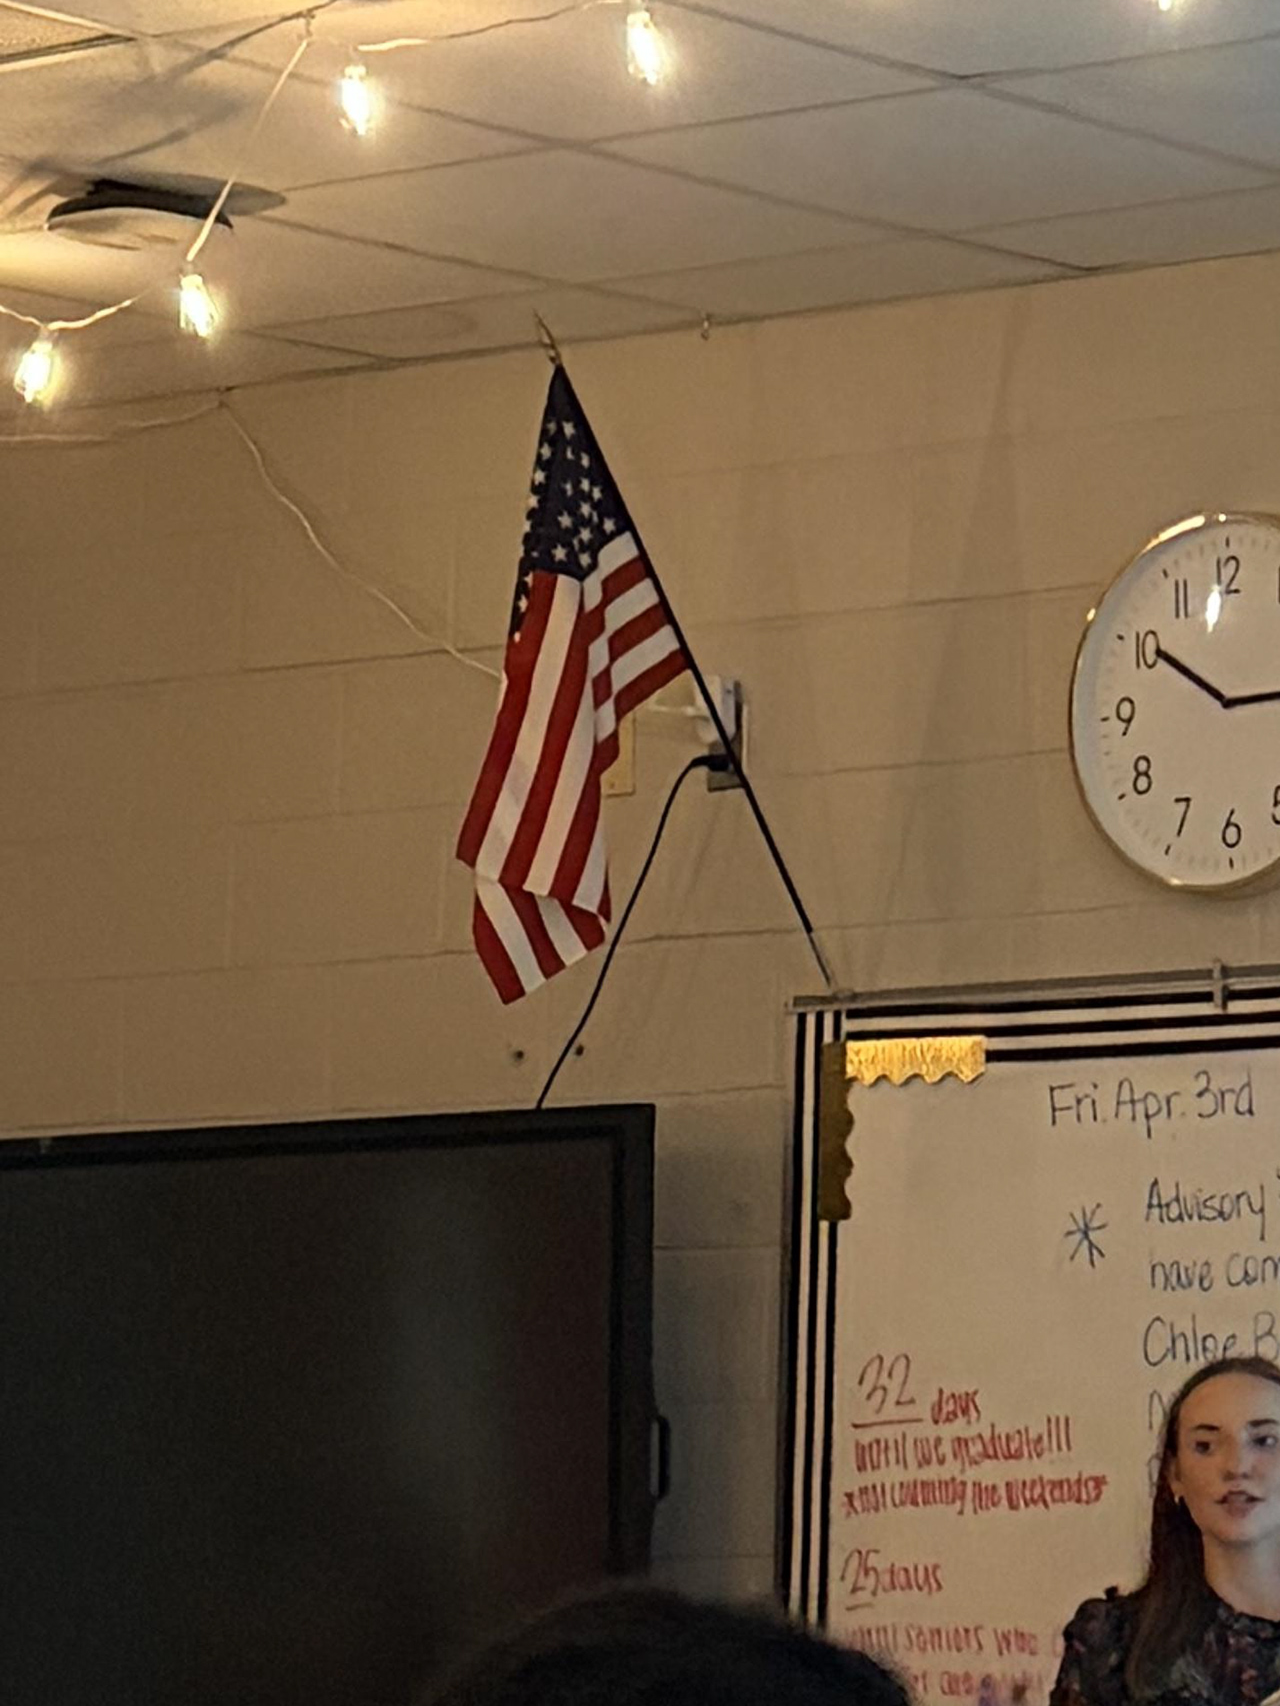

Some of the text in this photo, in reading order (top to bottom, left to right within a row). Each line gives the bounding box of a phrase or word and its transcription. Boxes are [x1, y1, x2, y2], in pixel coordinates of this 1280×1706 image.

[1215, 555, 1241, 595] 12
[1173, 578, 1190, 619] 11
[1135, 629, 1160, 670] 10
[1115, 696, 1136, 737] 9
[1132, 755, 1153, 795] 8
[1173, 797, 1192, 837] 7
[1221, 808, 1242, 849] 6
[1047, 1069, 1256, 1140] Fri. Apr. 3rd
[1144, 1177, 1267, 1242] Advisory
[1143, 1313, 1239, 1367] Chloe
[857, 1353, 981, 1426] 32 days
[840, 1548, 881, 1597] 25
